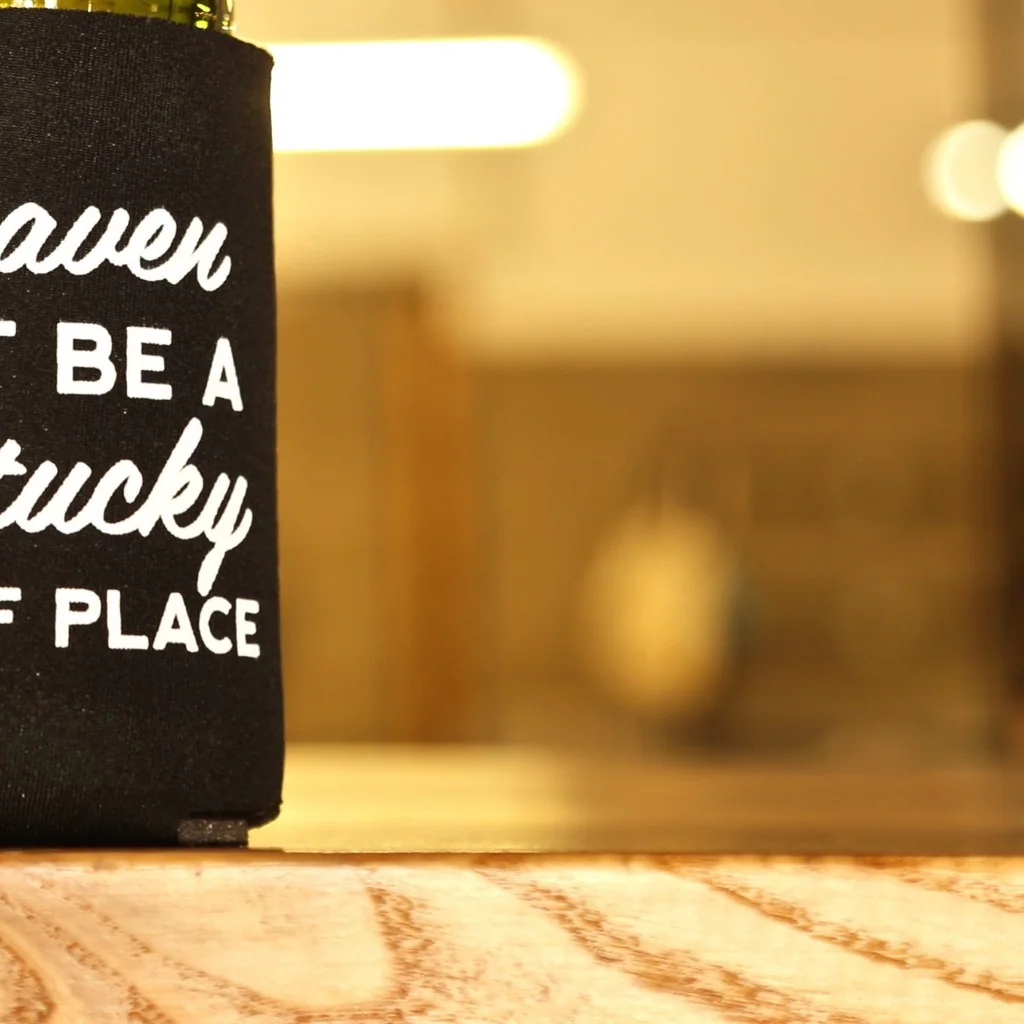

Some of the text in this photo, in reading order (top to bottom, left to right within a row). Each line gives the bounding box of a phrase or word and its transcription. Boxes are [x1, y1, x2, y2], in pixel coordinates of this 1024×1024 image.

[56, 321, 173, 401] BE
[201, 336, 244, 412] A
[54, 587, 261, 659] PLACE
